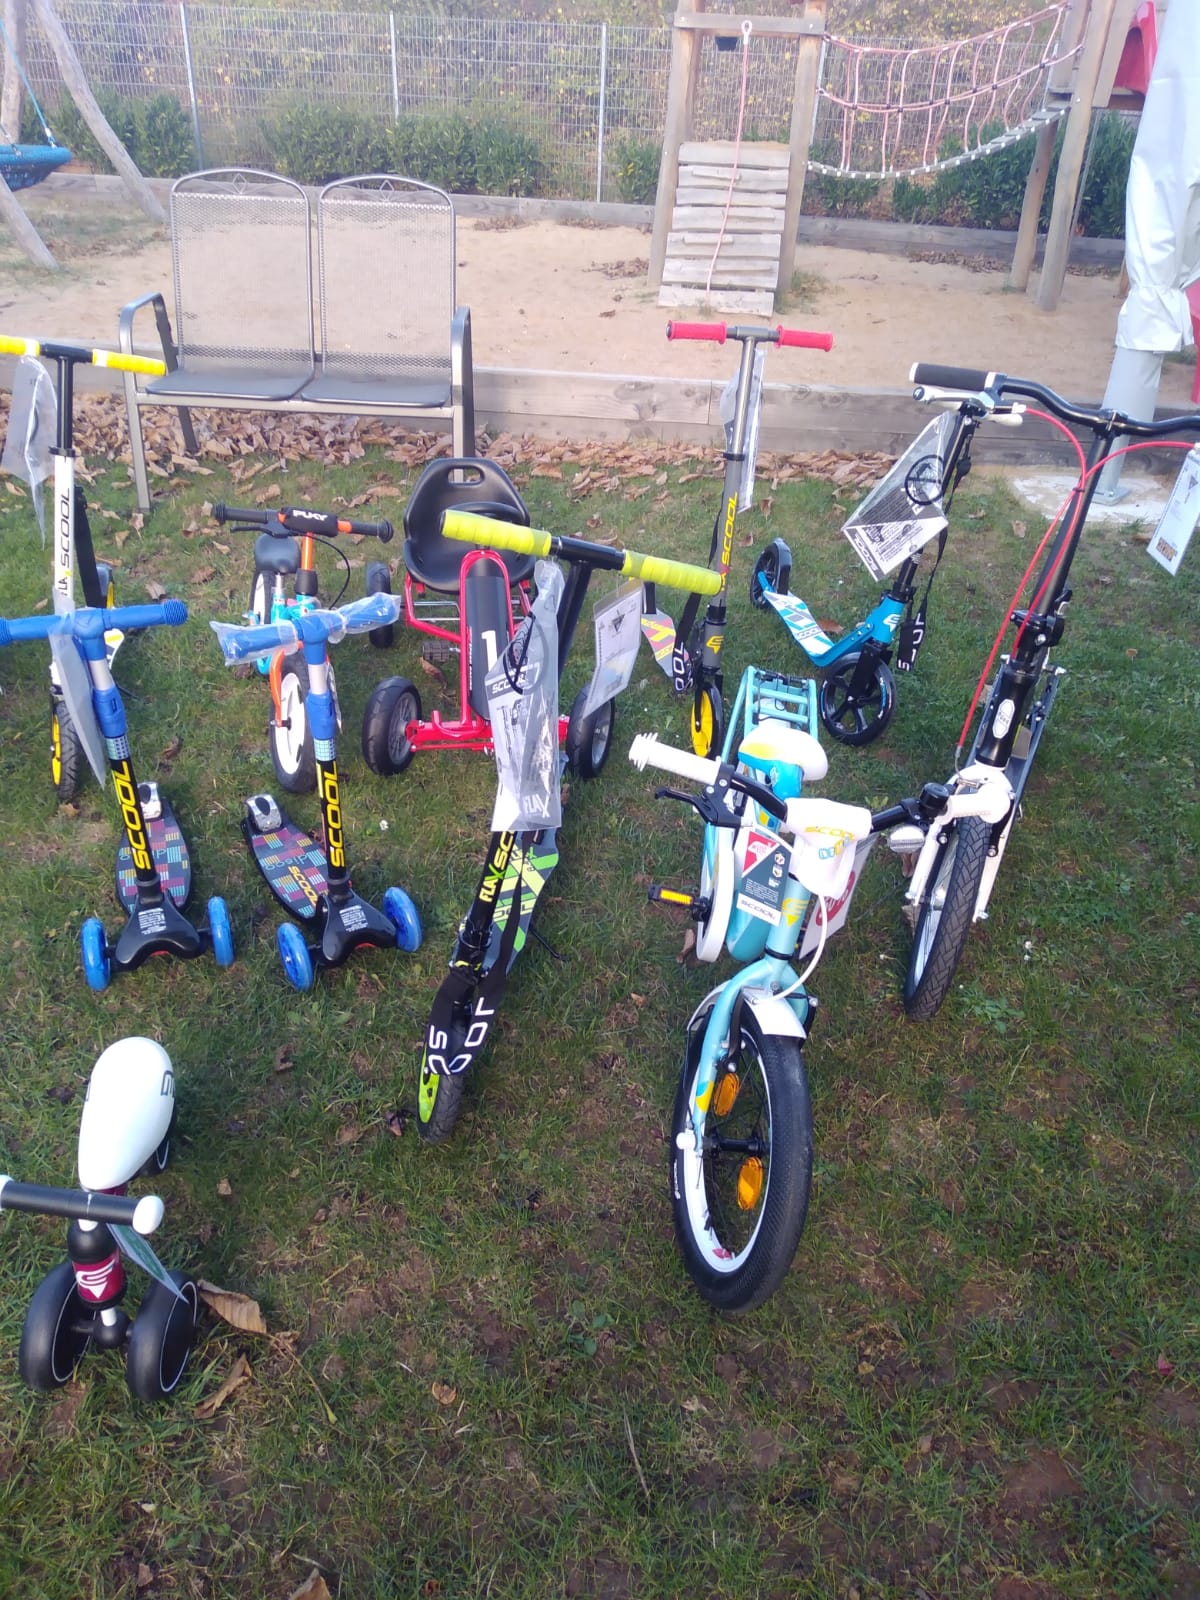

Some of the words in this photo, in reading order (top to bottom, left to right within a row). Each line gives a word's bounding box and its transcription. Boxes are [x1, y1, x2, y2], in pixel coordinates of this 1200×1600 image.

[60, 487, 70, 568] SCOOL
[721, 491, 738, 567] SCOOL
[114, 761, 152, 870] SCOOL
[323, 761, 345, 867] SCOOL
[265, 853, 308, 871] disco
[479, 863, 506, 903] FLAX
[428, 997, 495, 1075] SCOOL
